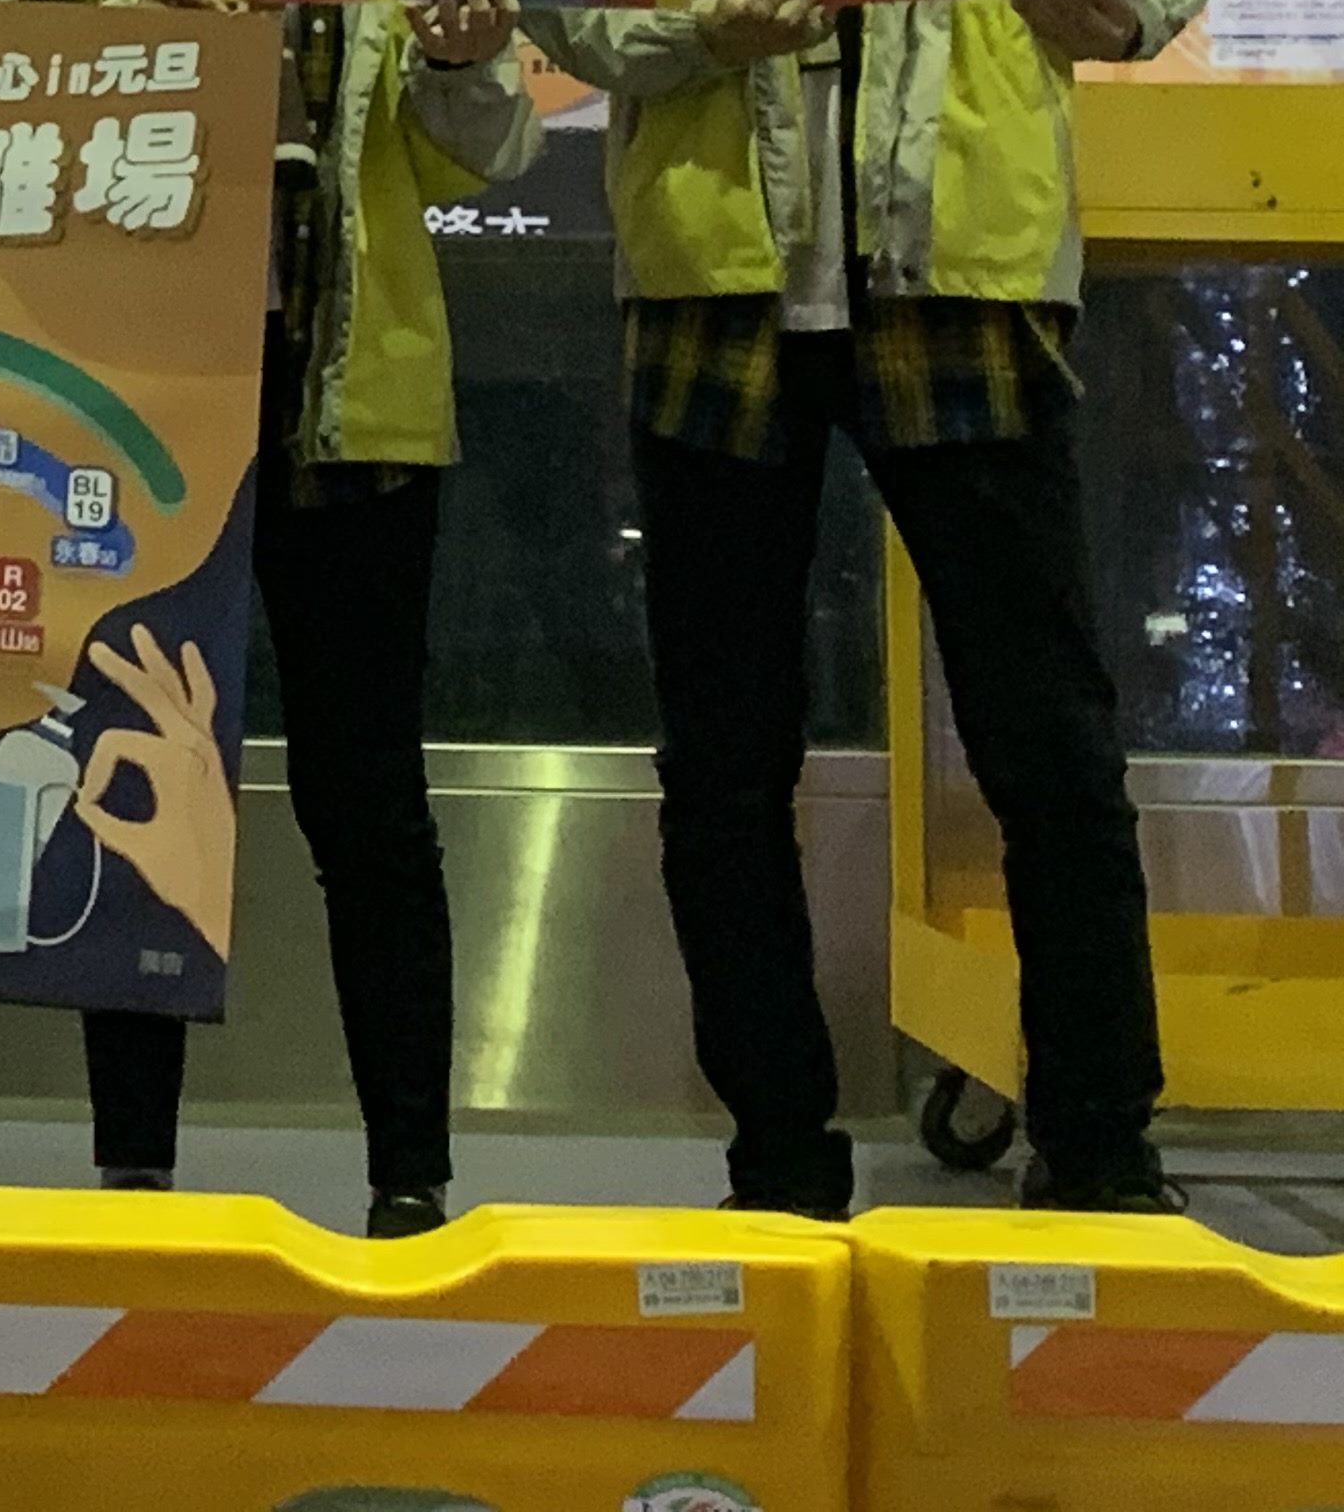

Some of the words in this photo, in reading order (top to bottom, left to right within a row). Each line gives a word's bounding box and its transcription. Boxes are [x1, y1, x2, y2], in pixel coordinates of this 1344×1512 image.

[73, 474, 108, 498] BL
[75, 500, 104, 522] 19
[3, 565, 23, 587] R
